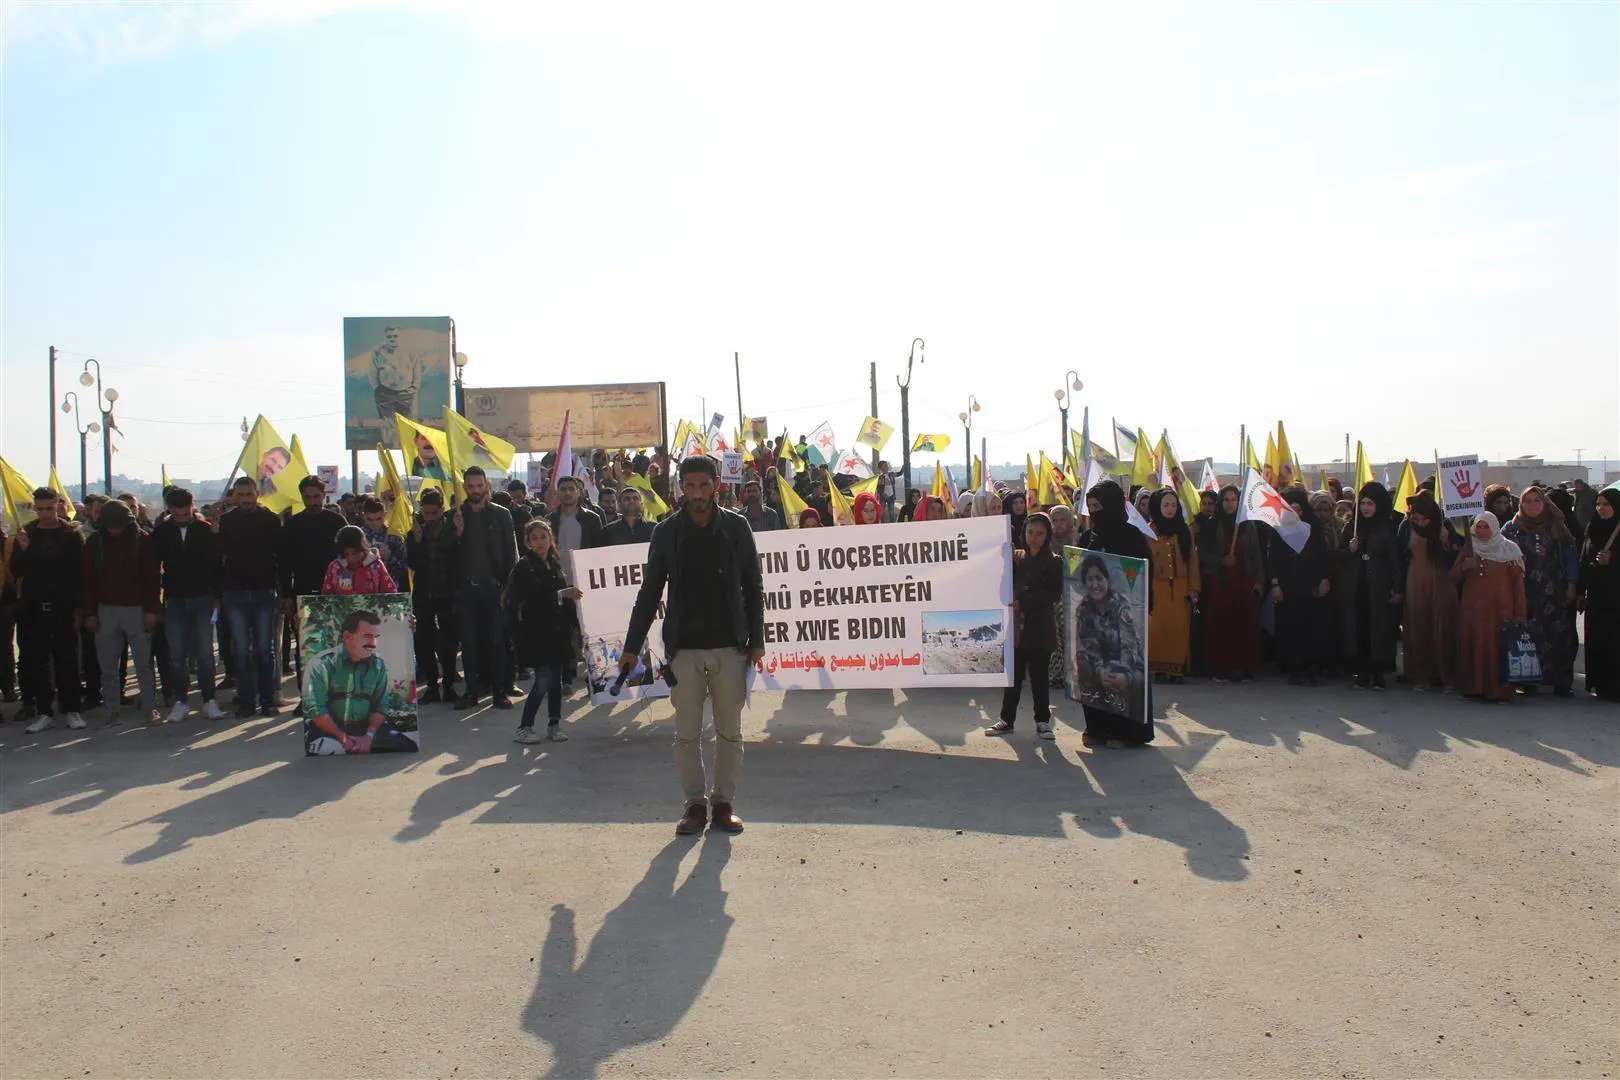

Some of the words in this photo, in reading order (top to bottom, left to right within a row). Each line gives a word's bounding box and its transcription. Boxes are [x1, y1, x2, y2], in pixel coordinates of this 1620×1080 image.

[588, 568, 606, 590] LI
[796, 543, 810, 572] Û
[818, 533, 969, 571] KOÇBERKIRINÊ
[800, 575, 932, 609] PÊKHATEYÊN
[796, 618, 840, 642] XWE
[850, 616, 906, 640] BIDIN
[780, 650, 825, 673] مكوناتنا
[830, 652, 866, 673] بجميع
[869, 650, 921, 672] صامدون
